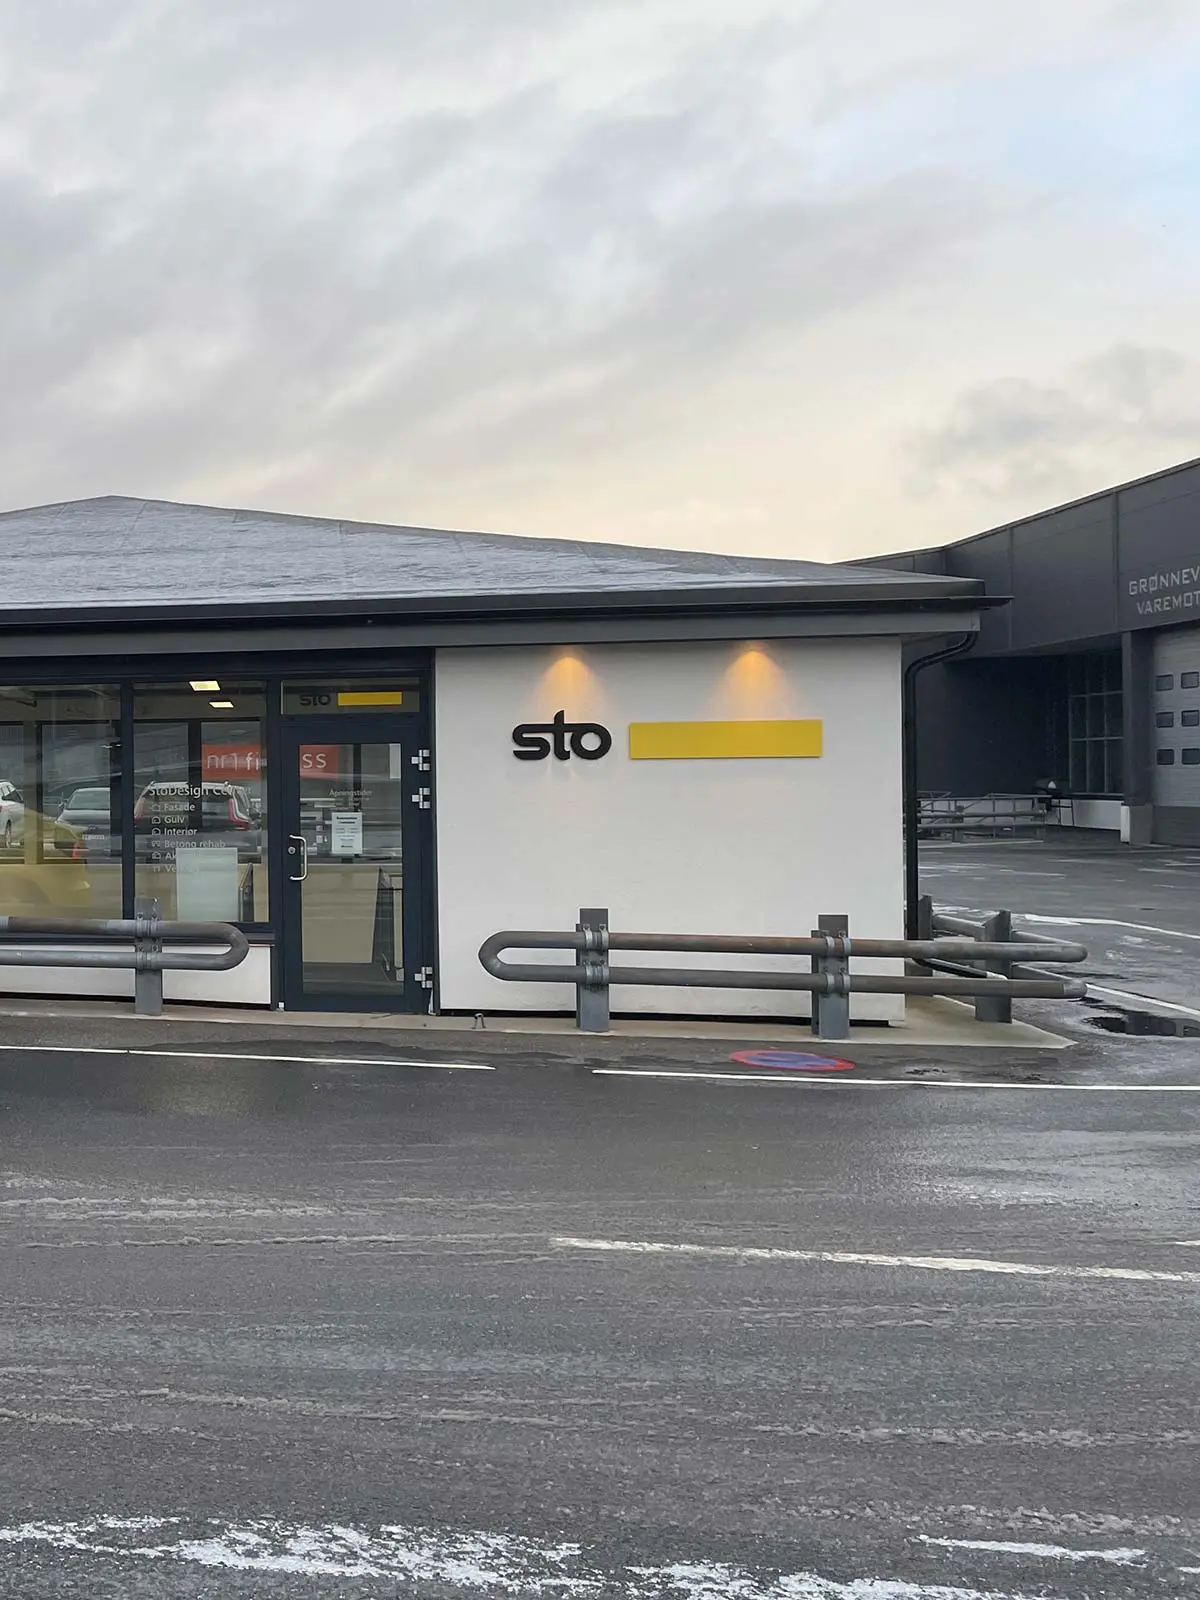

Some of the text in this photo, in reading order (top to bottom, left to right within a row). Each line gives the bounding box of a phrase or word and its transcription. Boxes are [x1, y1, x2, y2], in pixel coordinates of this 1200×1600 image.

[512, 709, 612, 761] sto
[164, 803, 196, 812] Fasade
[164, 815, 185, 824] Gulv
